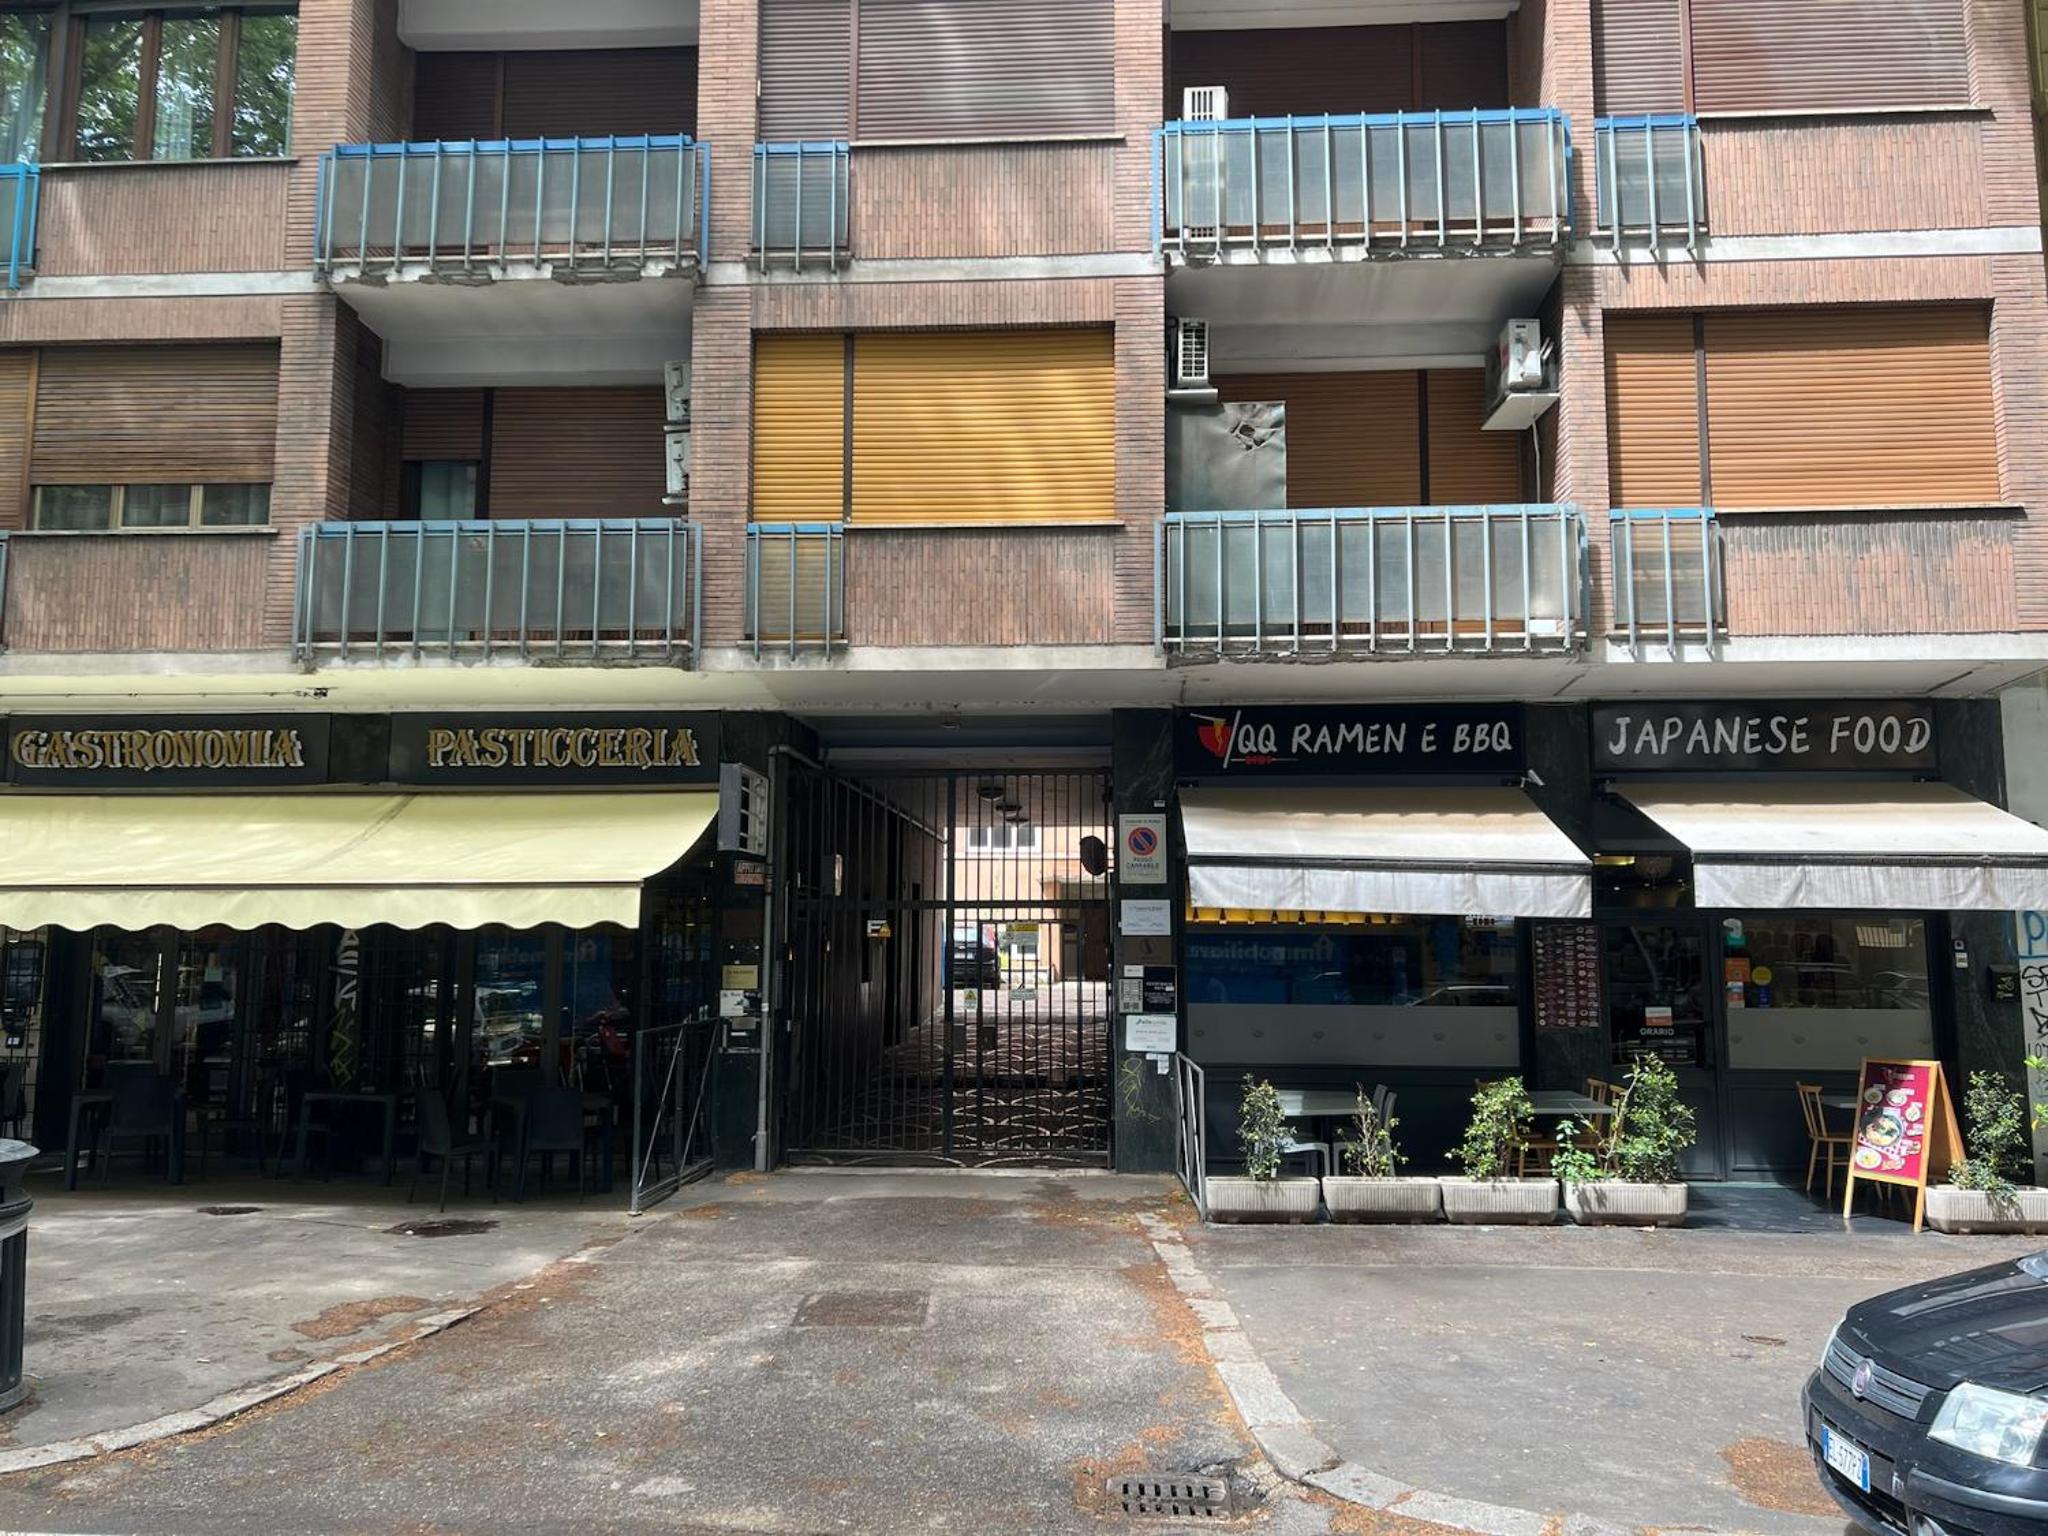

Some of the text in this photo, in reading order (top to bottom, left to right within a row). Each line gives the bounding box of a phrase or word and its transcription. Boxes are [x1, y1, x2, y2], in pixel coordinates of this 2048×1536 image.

[12, 729, 305, 770] GASTRONOMIA
[427, 728, 701, 769] PASTICCERIA
[1237, 721, 1514, 755] QQ RAMEN E BBQ
[1608, 715, 1932, 756] JAPANESE FOOD
[1639, 1027, 1675, 1036] ORARIO
